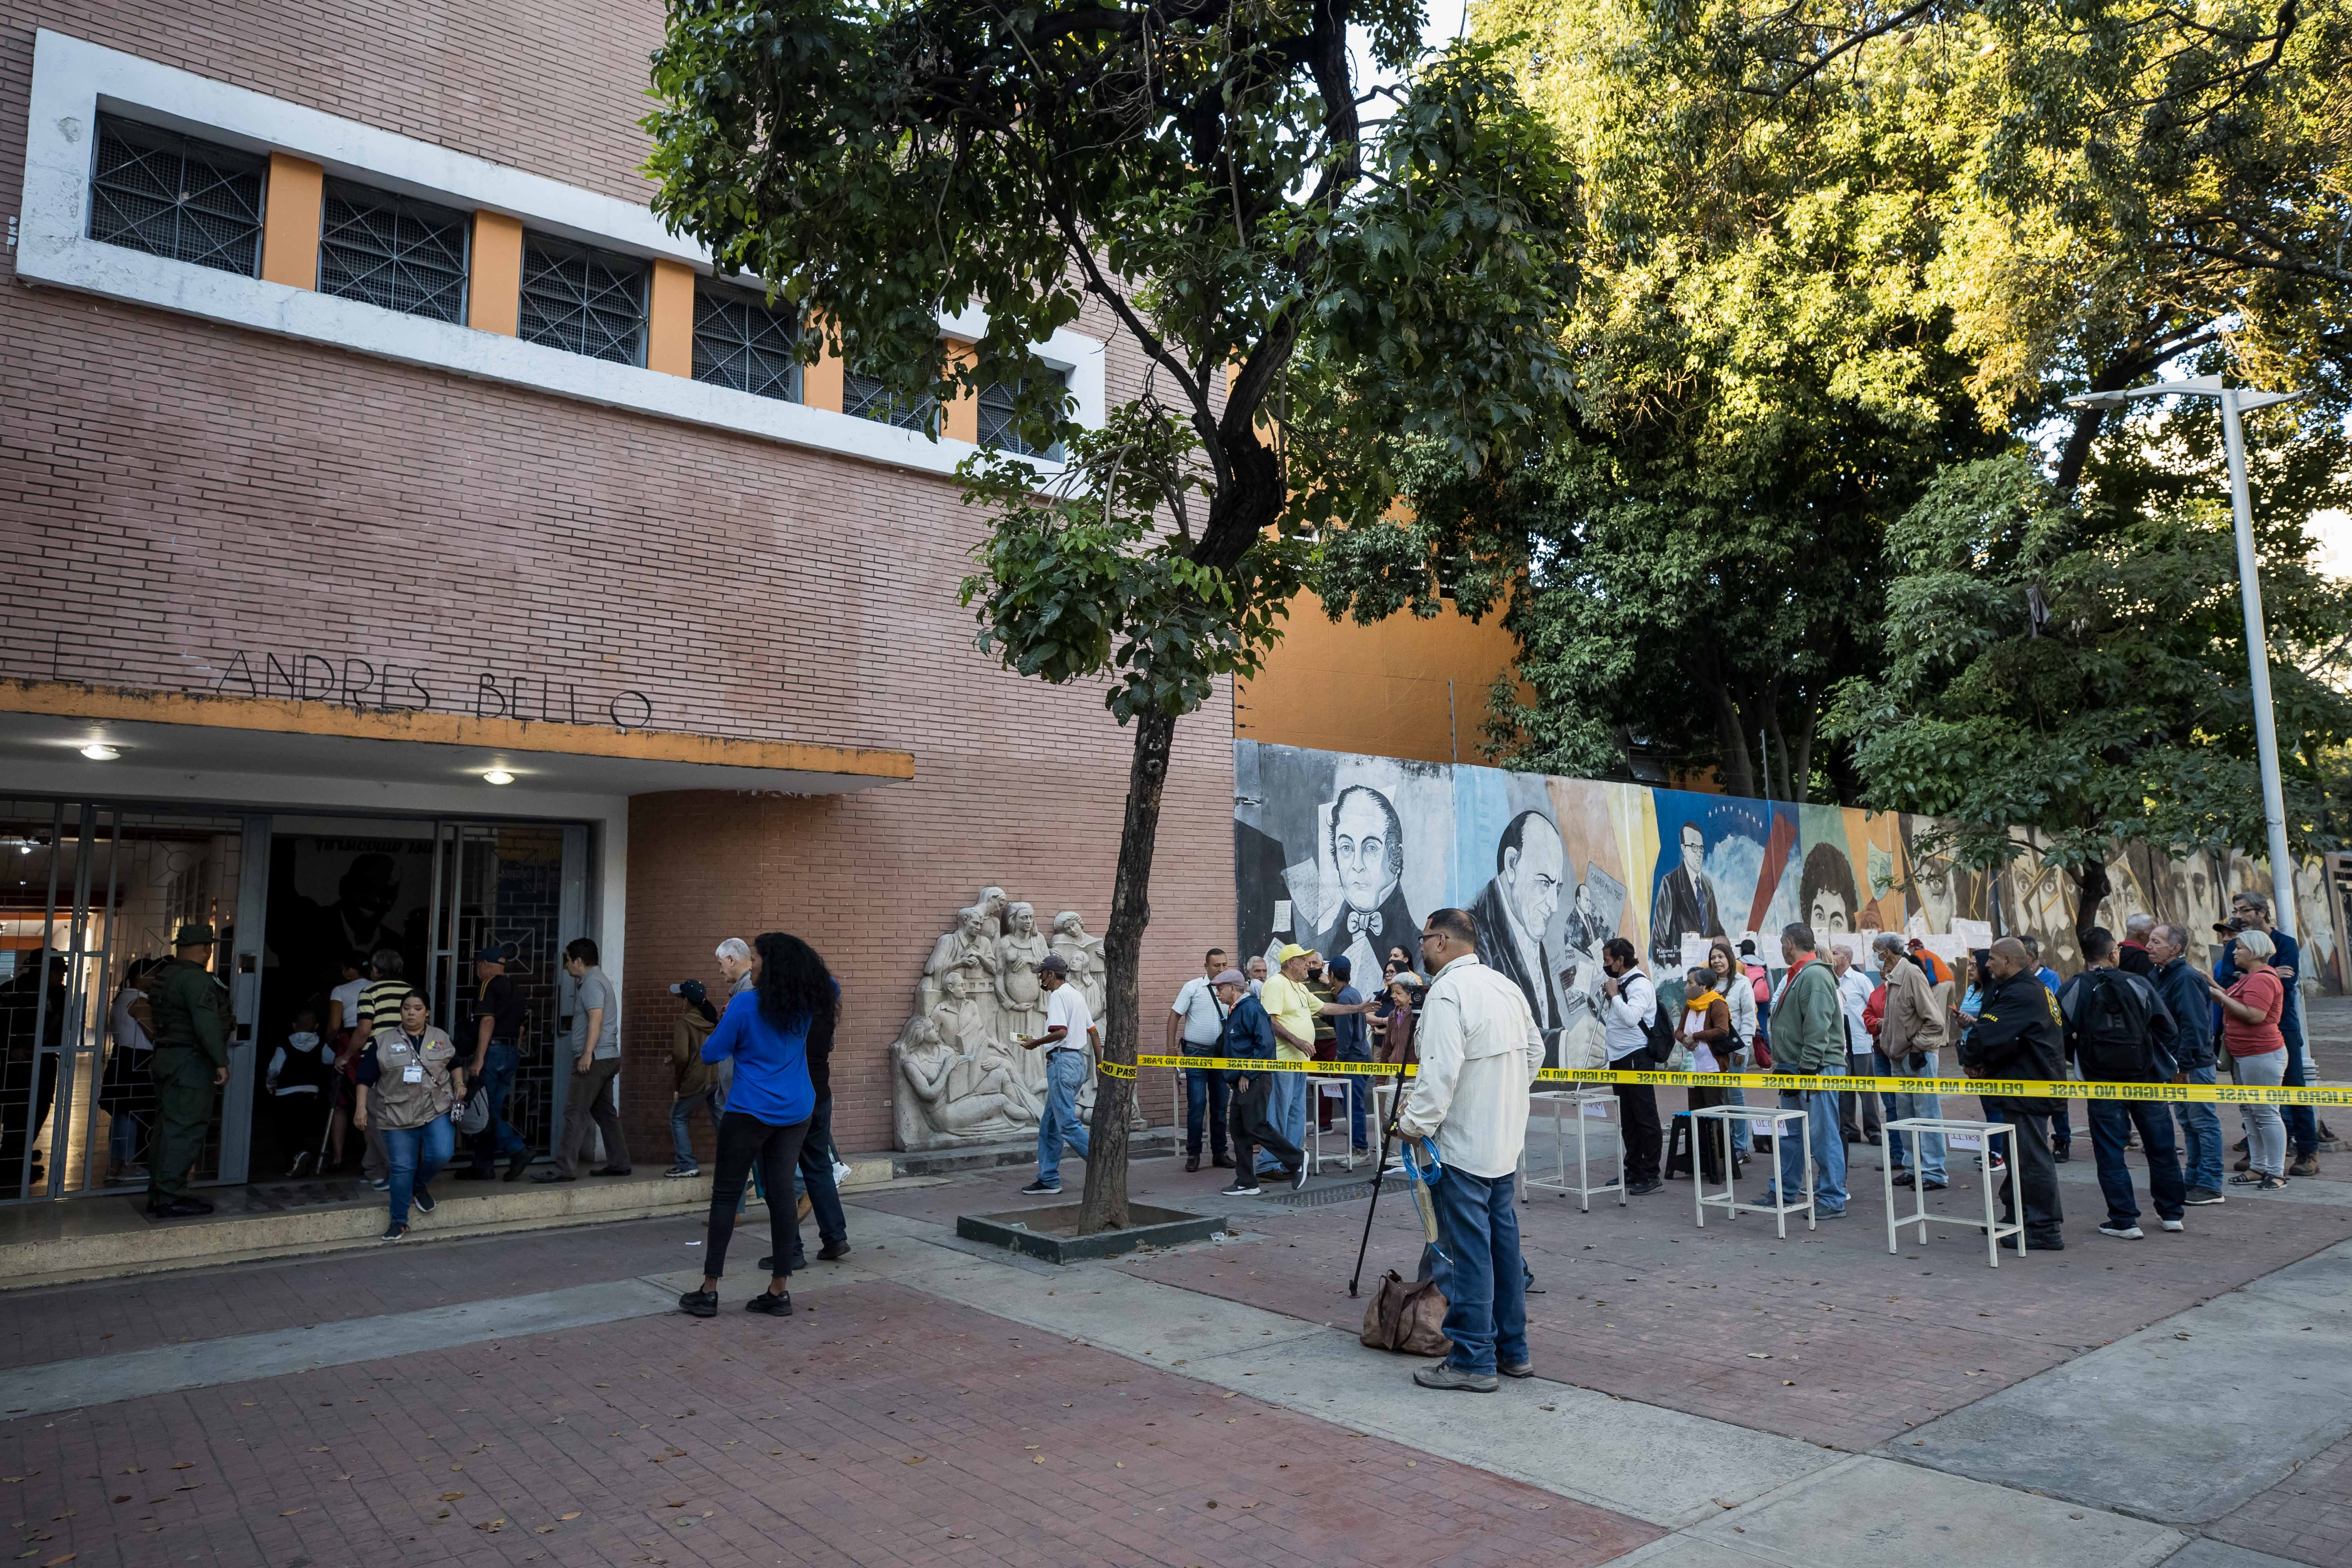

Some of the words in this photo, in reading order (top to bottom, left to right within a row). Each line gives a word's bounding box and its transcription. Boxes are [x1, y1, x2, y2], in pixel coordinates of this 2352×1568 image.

[216, 650, 430, 711] ANDRES
[477, 673, 652, 728] BELLO
[1103, 1063, 1114, 1074] NO
[1116, 1067, 1136, 1077] PASE
